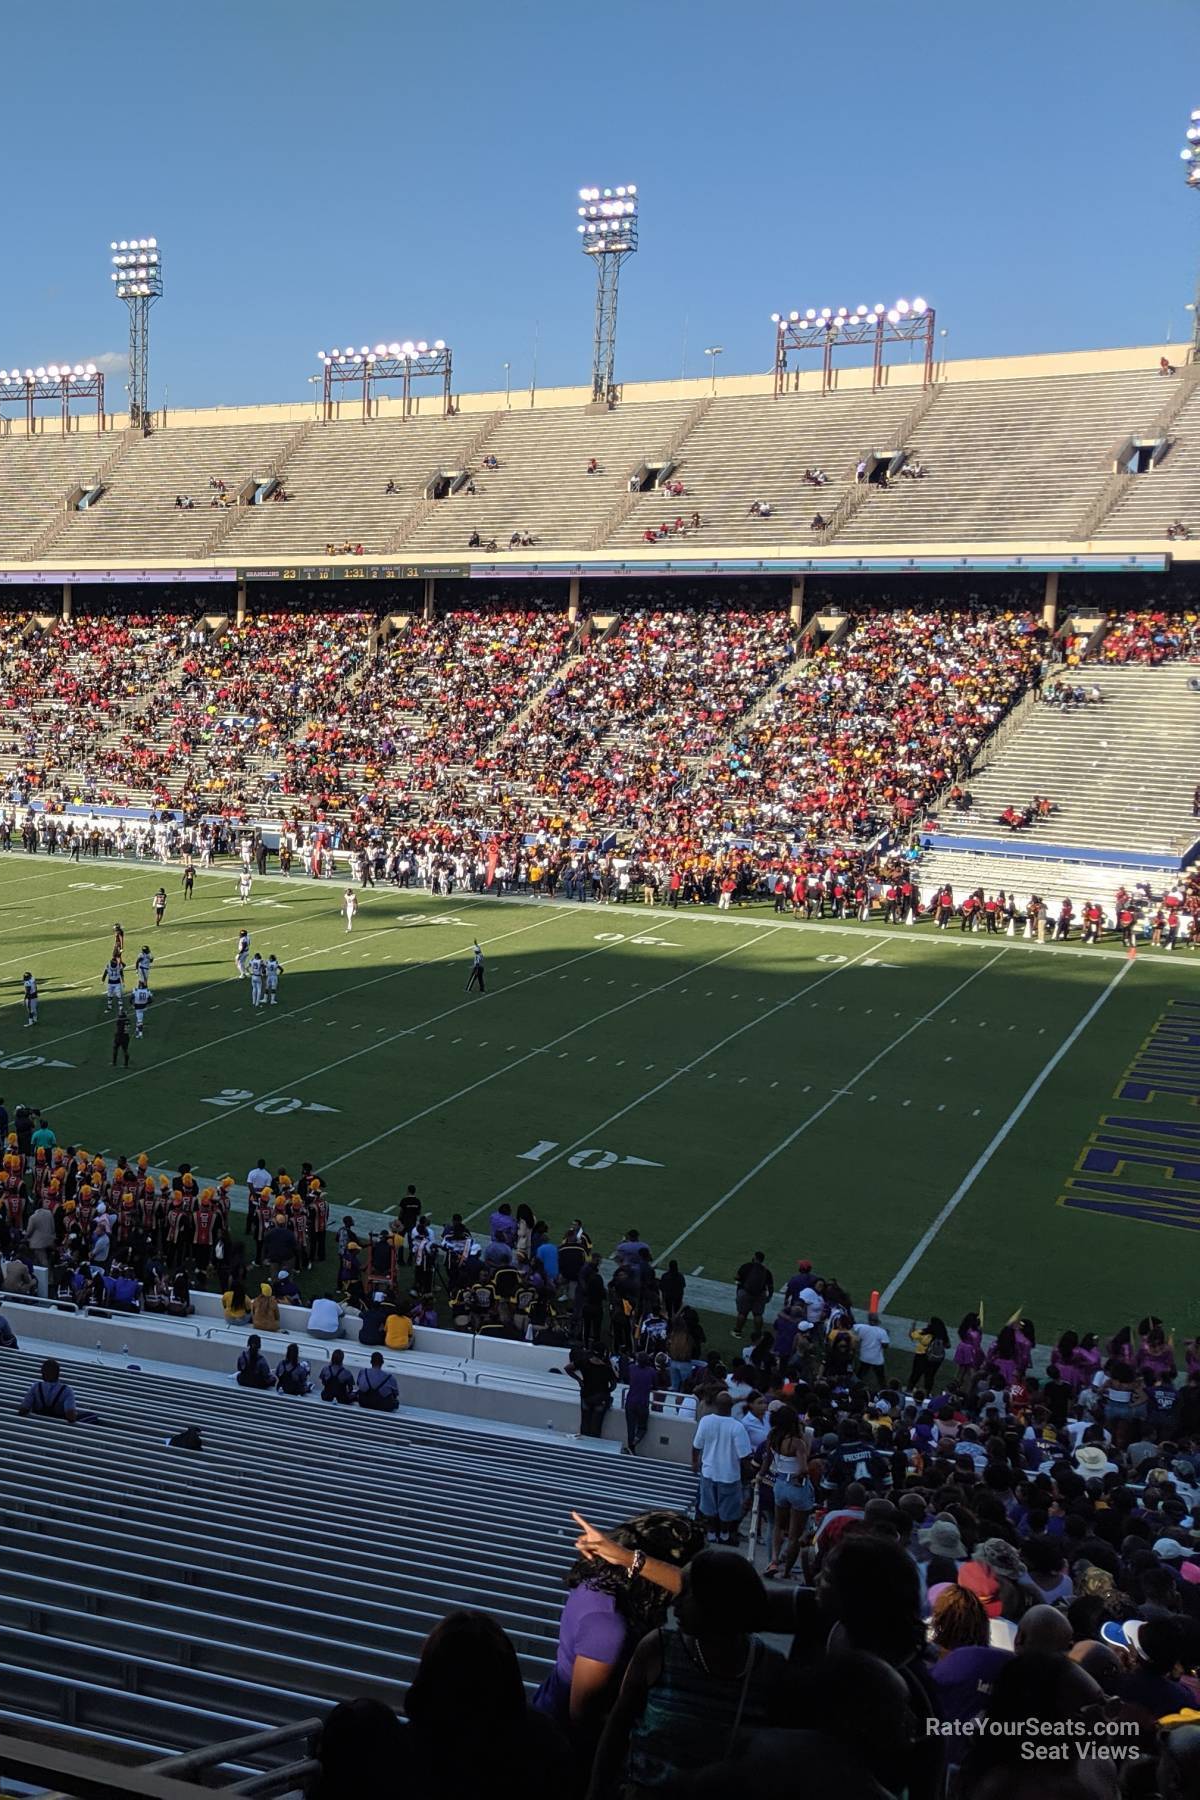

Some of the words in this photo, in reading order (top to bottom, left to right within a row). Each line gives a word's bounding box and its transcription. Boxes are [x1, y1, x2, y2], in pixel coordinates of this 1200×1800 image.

[283, 569, 296, 579] 23
[343, 568, 365, 578] 1:31
[406, 568, 419, 577] 31
[200, 1089, 302, 1114] 20
[516, 1140, 618, 1170] 10
[854, 1461, 872, 1481] 4
